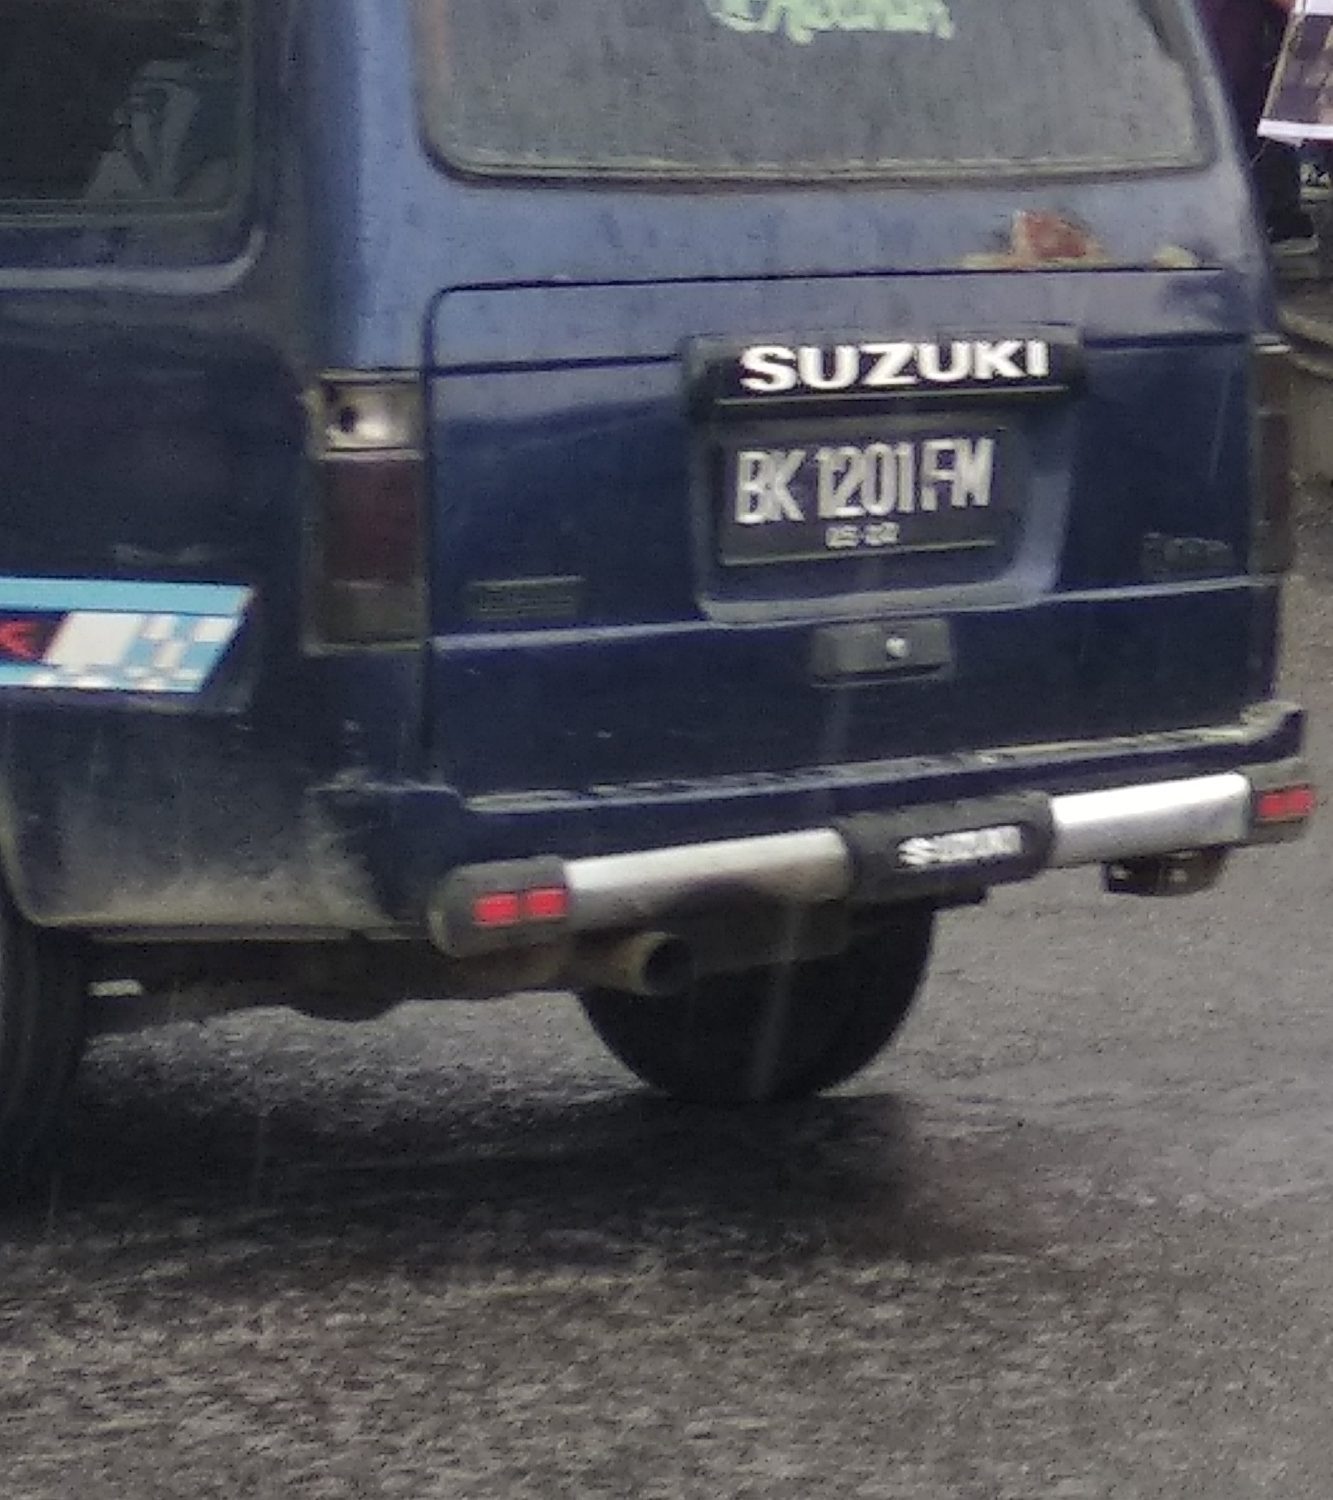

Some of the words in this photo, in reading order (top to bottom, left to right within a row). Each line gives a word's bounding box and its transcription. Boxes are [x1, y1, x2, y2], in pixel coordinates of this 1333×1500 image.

[739, 340, 1050, 392] SUZUKI
[734, 449, 806, 524] BK
[815, 441, 916, 519] 1201
